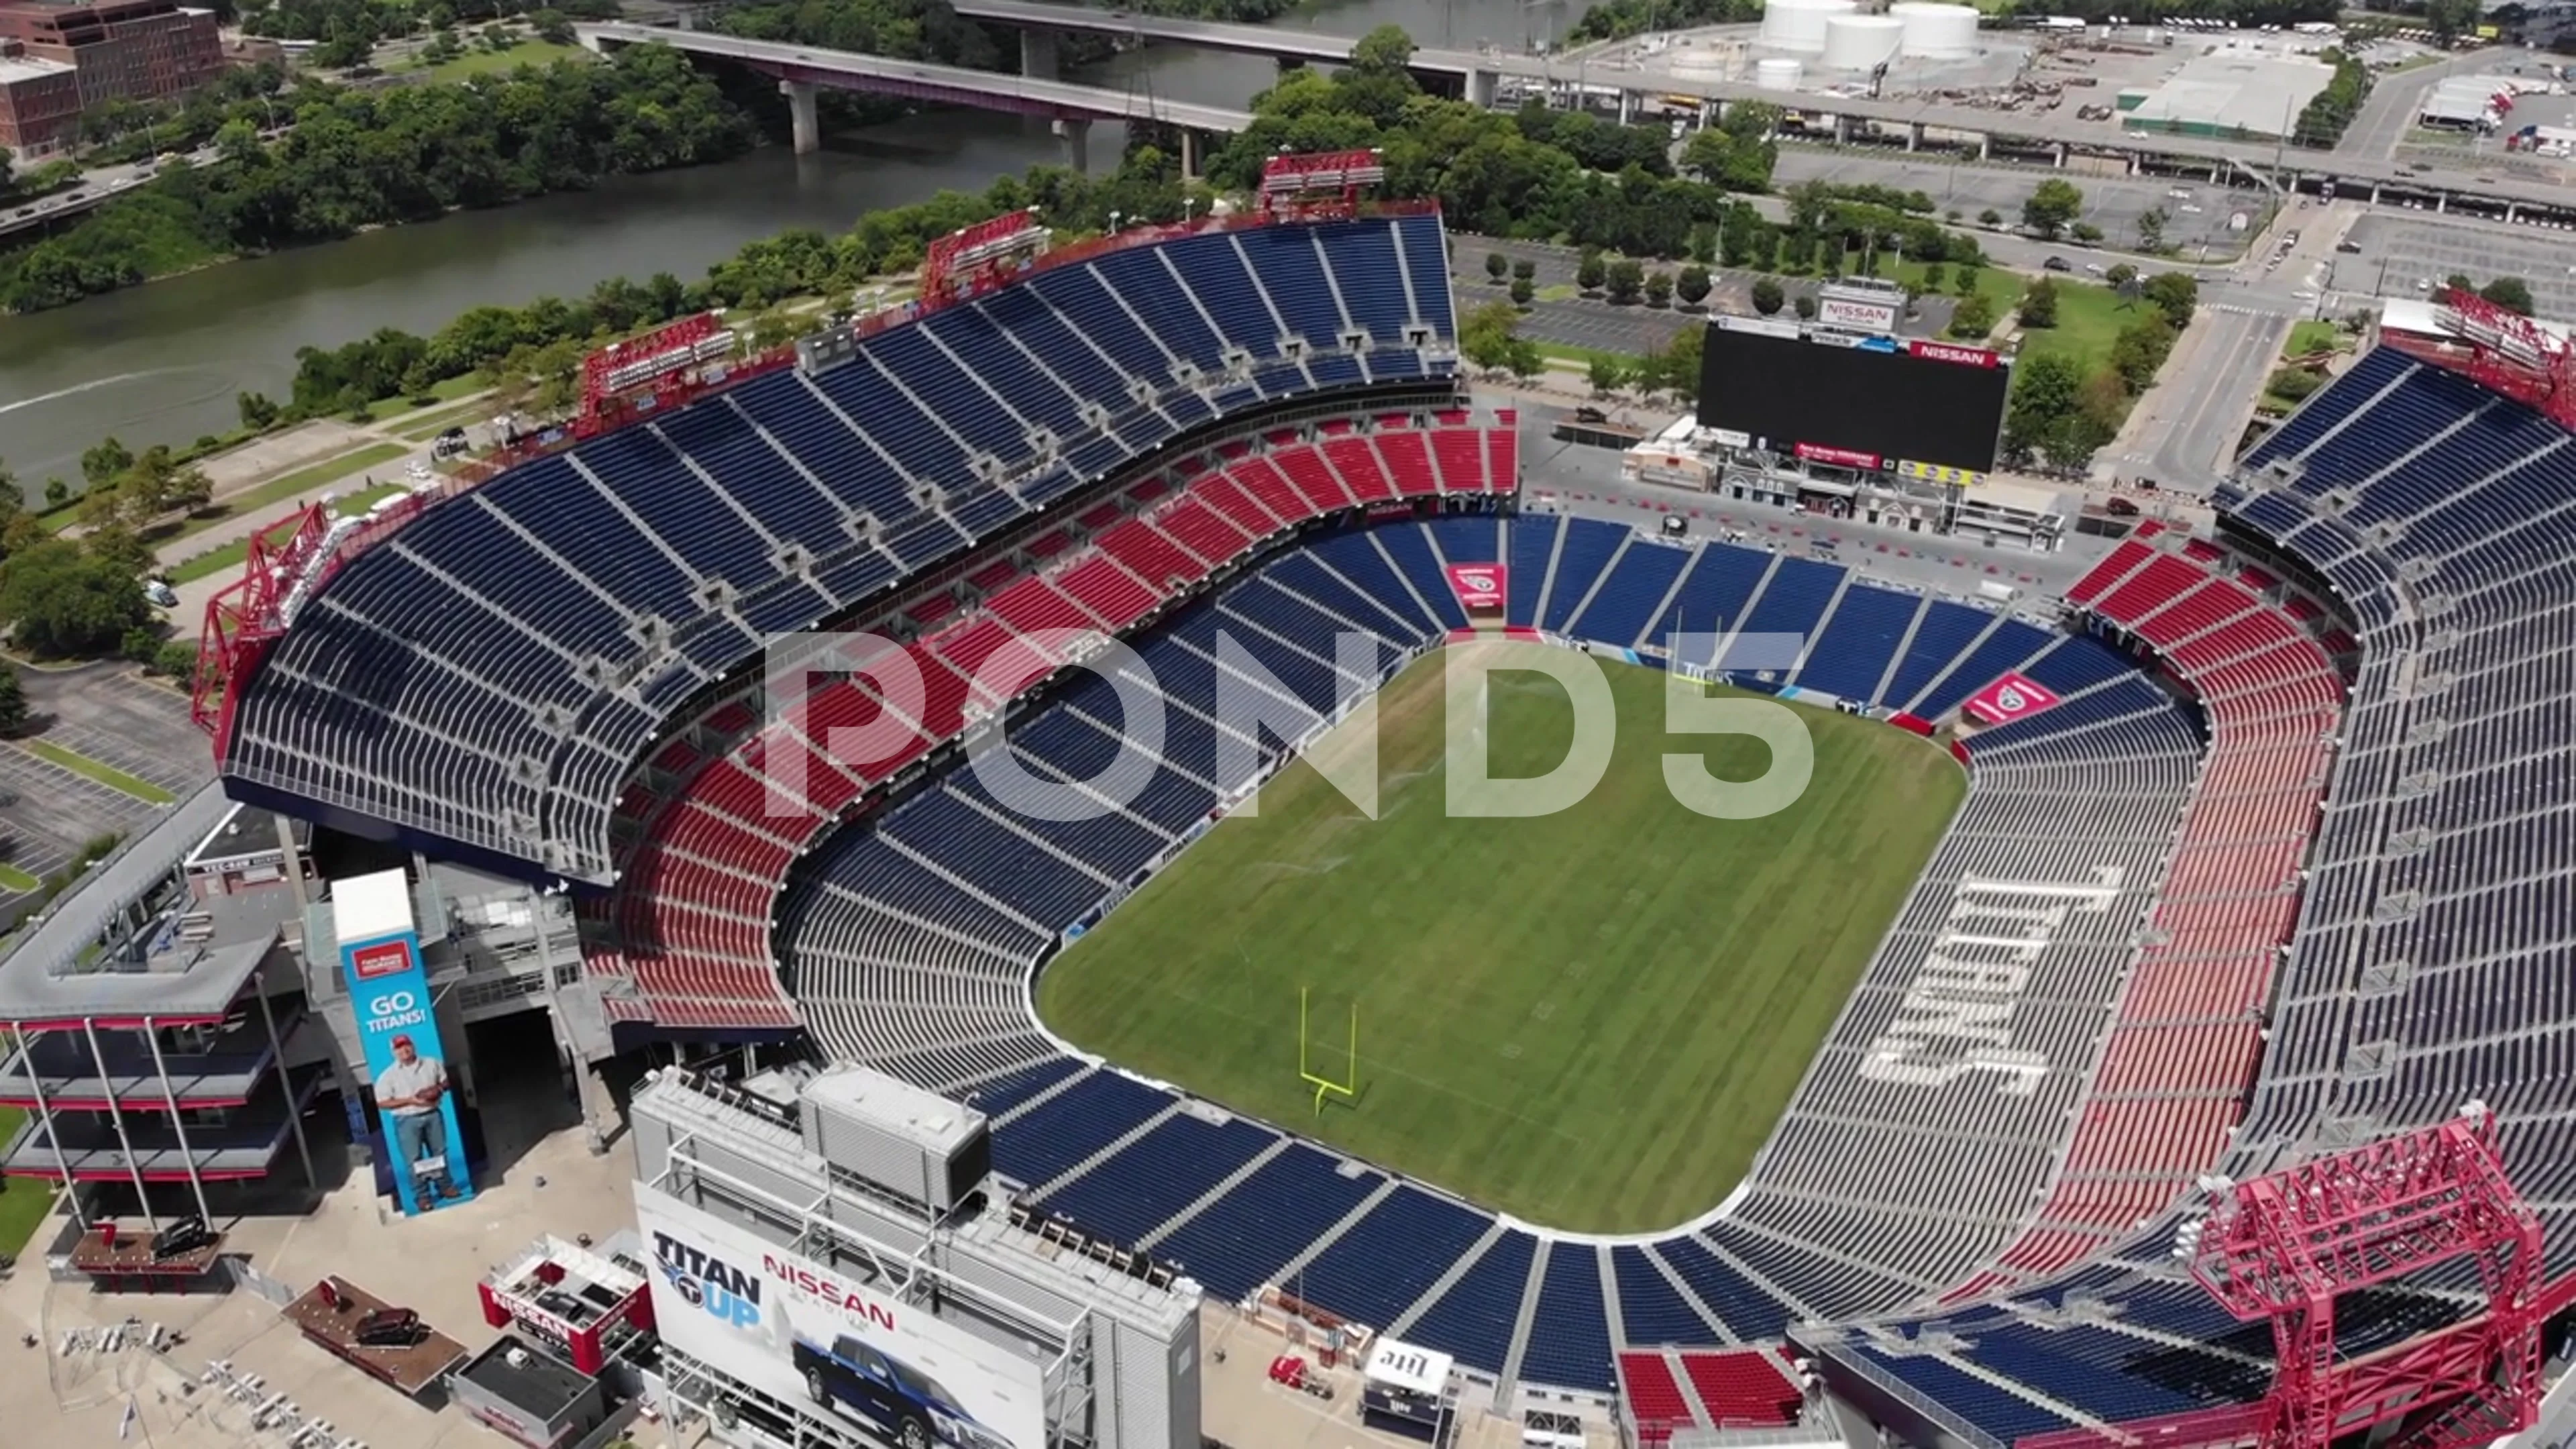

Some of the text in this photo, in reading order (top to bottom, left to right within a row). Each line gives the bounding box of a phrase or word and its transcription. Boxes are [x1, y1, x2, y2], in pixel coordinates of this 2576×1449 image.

[1826, 303, 1888, 321] NISSAN
[1921, 345, 1986, 364] NISSAN
[366, 1008, 426, 1033] TITANS!
[370, 991, 414, 1016] GO
[653, 1230, 760, 1306] TITAN
[702, 1281, 760, 1329] UP
[763, 1254, 895, 1331] NISSAN
[491, 1291, 570, 1340] NISSAN
